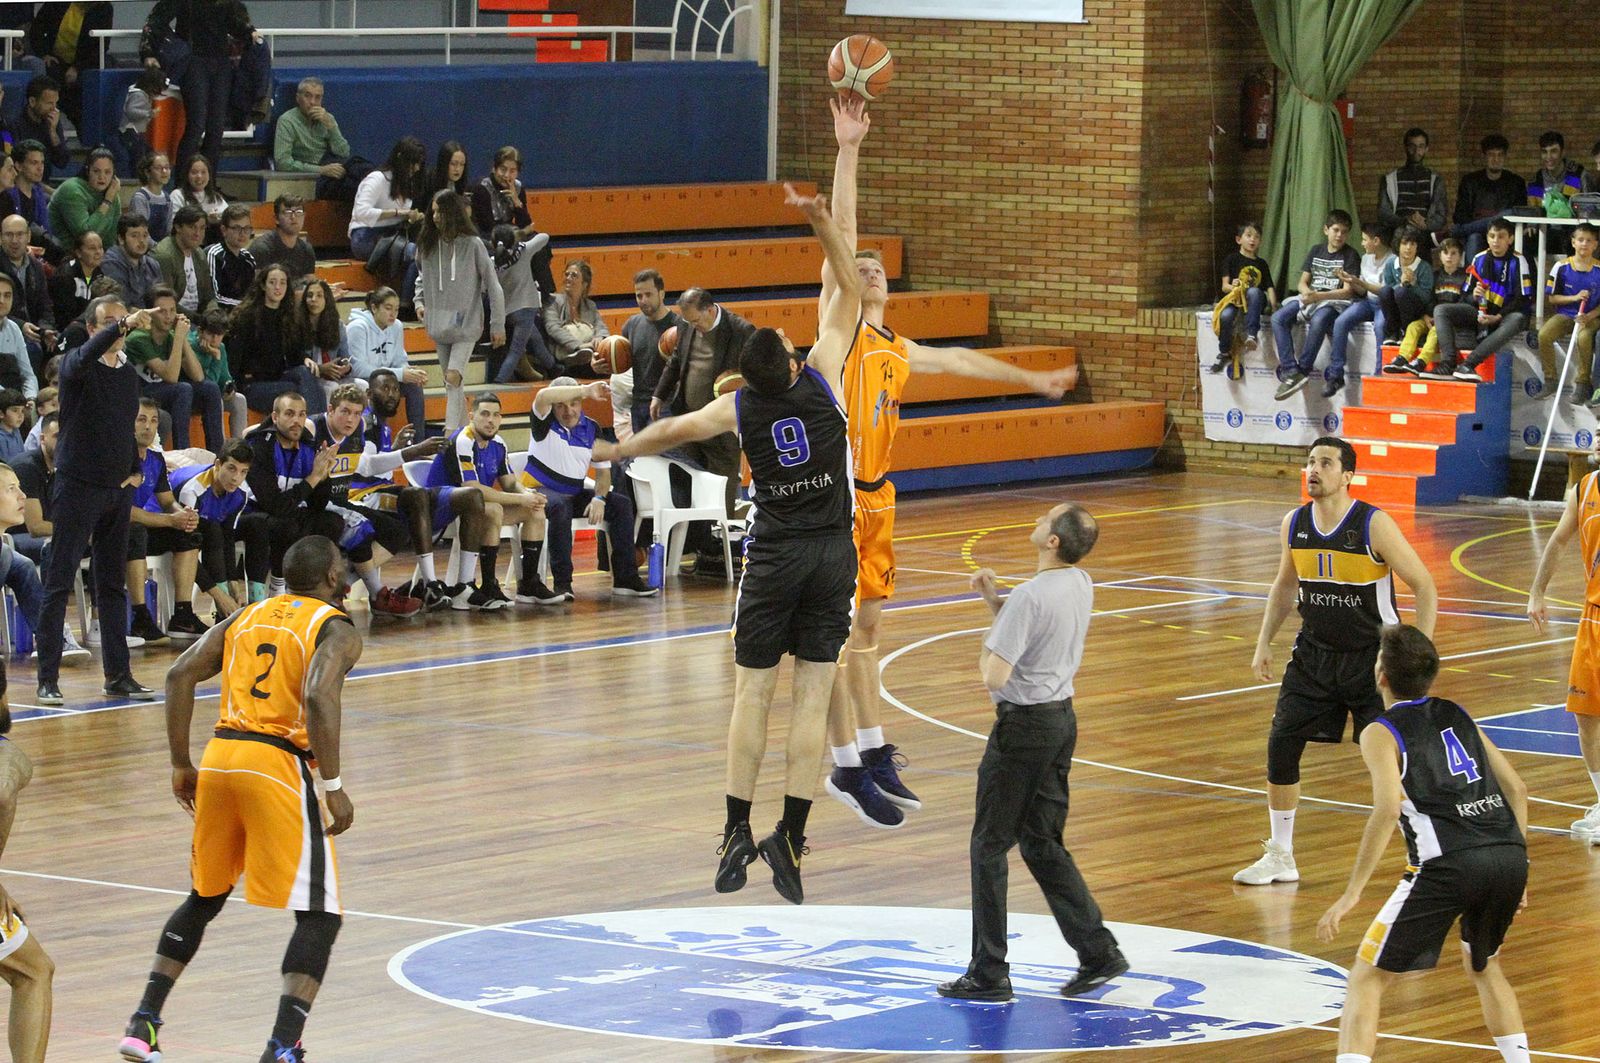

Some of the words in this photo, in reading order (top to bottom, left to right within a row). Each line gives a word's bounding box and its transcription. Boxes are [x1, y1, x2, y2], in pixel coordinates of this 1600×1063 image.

[771, 416, 811, 468] 9
[330, 456, 349, 474] 20
[1316, 552, 1333, 578] 11
[1309, 591, 1363, 608] KRYPTEIA
[250, 643, 278, 699] 2
[1440, 726, 1483, 784] 4
